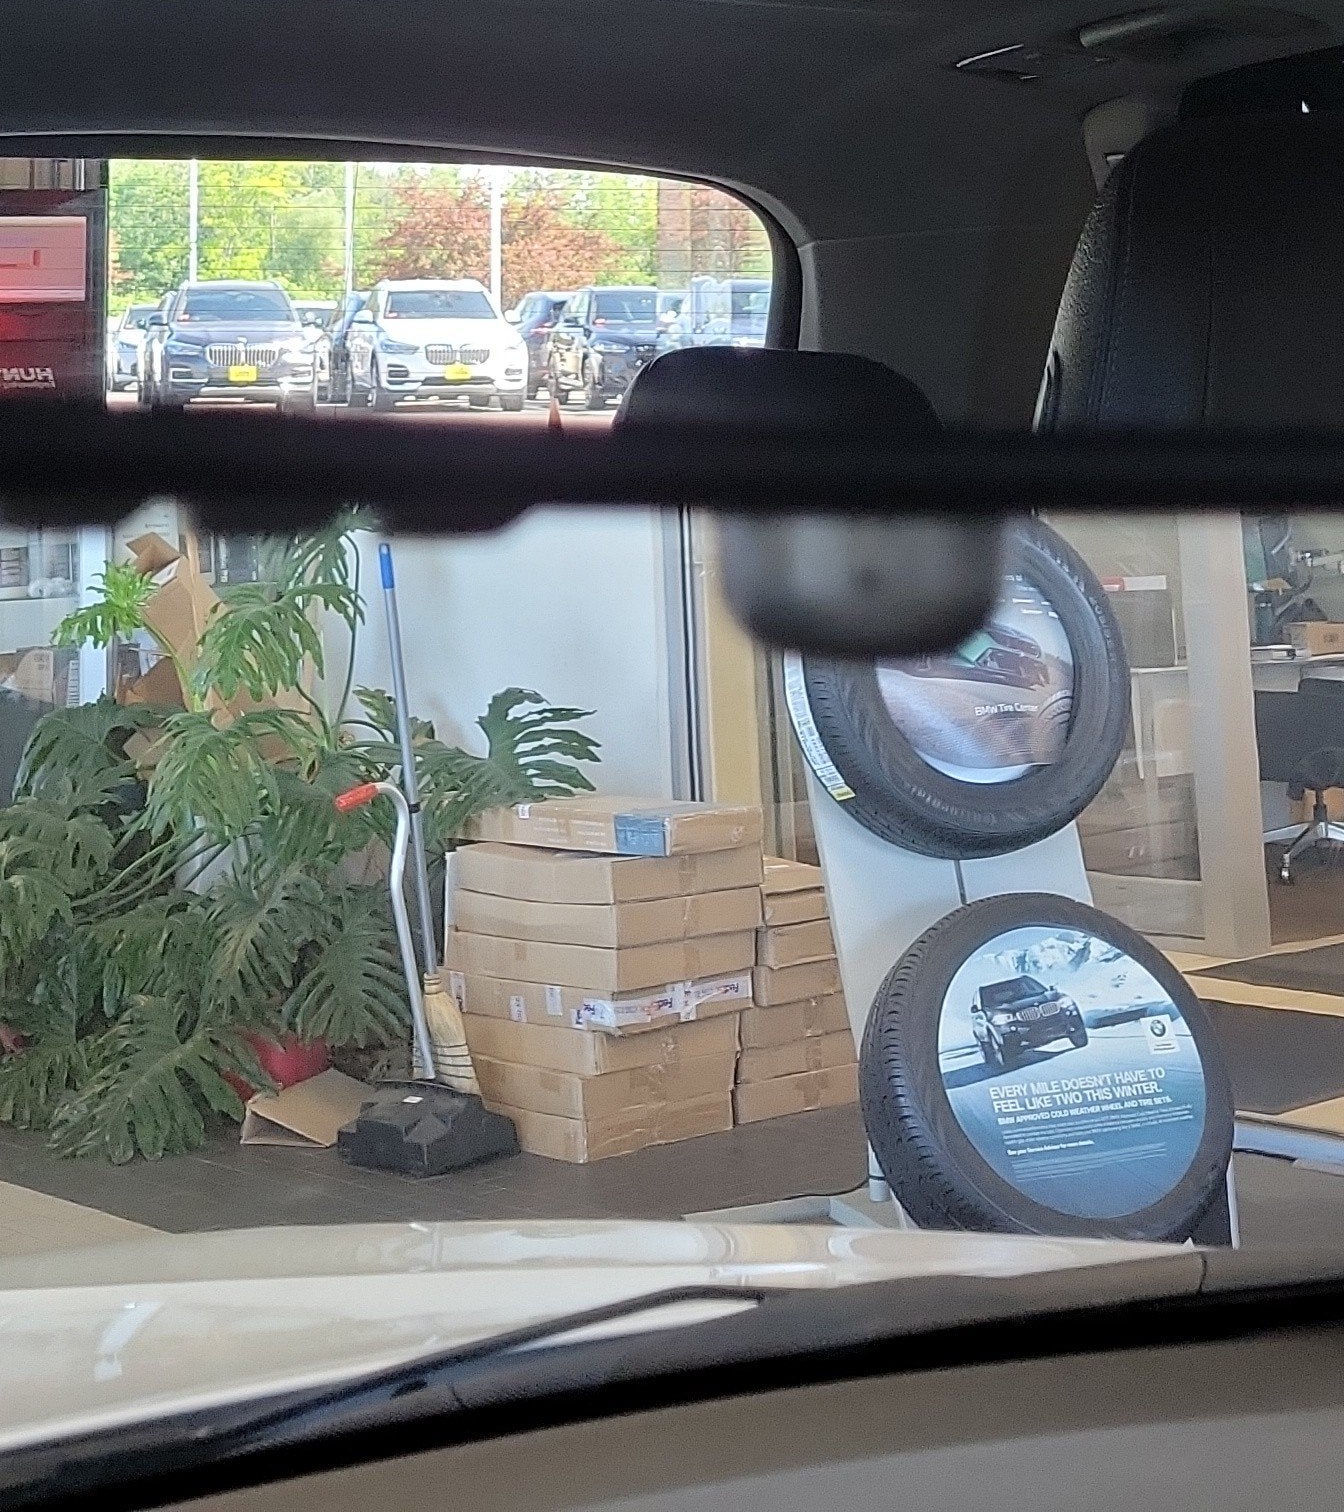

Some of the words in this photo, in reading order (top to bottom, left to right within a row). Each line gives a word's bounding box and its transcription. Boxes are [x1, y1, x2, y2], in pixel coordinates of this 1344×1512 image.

[974, 704, 998, 716] BMW
[989, 1083, 1028, 1100] EVERY
[1030, 1080, 1061, 1095] MILE
[1061, 1073, 1112, 1092] DOESN'T
[1114, 1069, 1148, 1085] HAVE
[1147, 1067, 1165, 1079] TO
[993, 1098, 1025, 1113] FEEL
[1025, 1095, 1053, 1110] LIKE
[1053, 1091, 1083, 1106] TWO
[1083, 1087, 1113, 1101] THIS
[1113, 1081, 1163, 1098] WINTER.
[1016, 1113, 1050, 1123] APPROVED
[1050, 1109, 1070, 1119] COLD
[1069, 1105, 1101, 1116] WEATHER
[1101, 1102, 1124, 1112] WHEEL
[1123, 1100, 1139, 1108] AND
